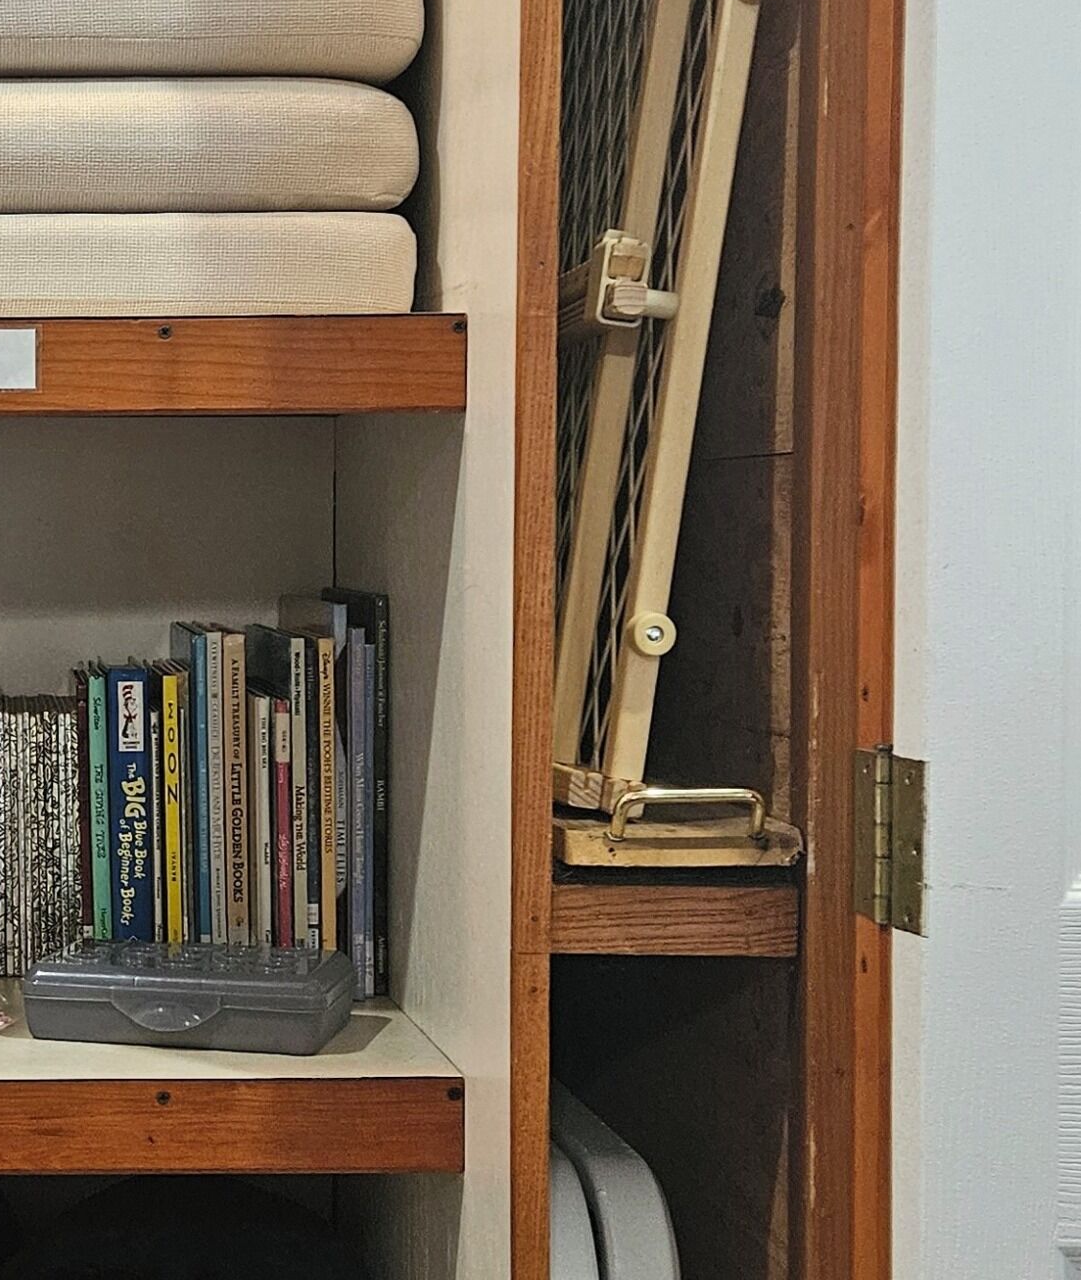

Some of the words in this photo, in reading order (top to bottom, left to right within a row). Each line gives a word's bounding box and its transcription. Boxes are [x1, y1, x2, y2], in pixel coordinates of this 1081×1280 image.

[232, 667, 240, 699] FAMILY
[323, 684, 332, 715] WINNIE
[232, 702, 240, 748] TREASURY
[323, 720, 332, 736] THE
[232, 748, 240, 760] OF
[324, 740, 332, 773] POOH'S
[94, 764, 104, 784] THE
[126, 762, 136, 779] The
[230, 762, 242, 806] LITTLE
[121, 776, 147, 818] BIG
[294, 786, 305, 822] Making
[324, 776, 333, 814] BEDTIME
[376, 780, 385, 811] BAMBI
[119, 818, 130, 830] of
[133, 821, 147, 848] Blue
[232, 808, 244, 859] GOLDEN
[324, 817, 334, 854] STORIES
[337, 819, 346, 847] TIME
[118, 832, 135, 886] Beginner
[132, 848, 147, 879] Book
[296, 844, 305, 871] World
[233, 862, 244, 903] BOOKS
[120, 888, 136, 926] Books
